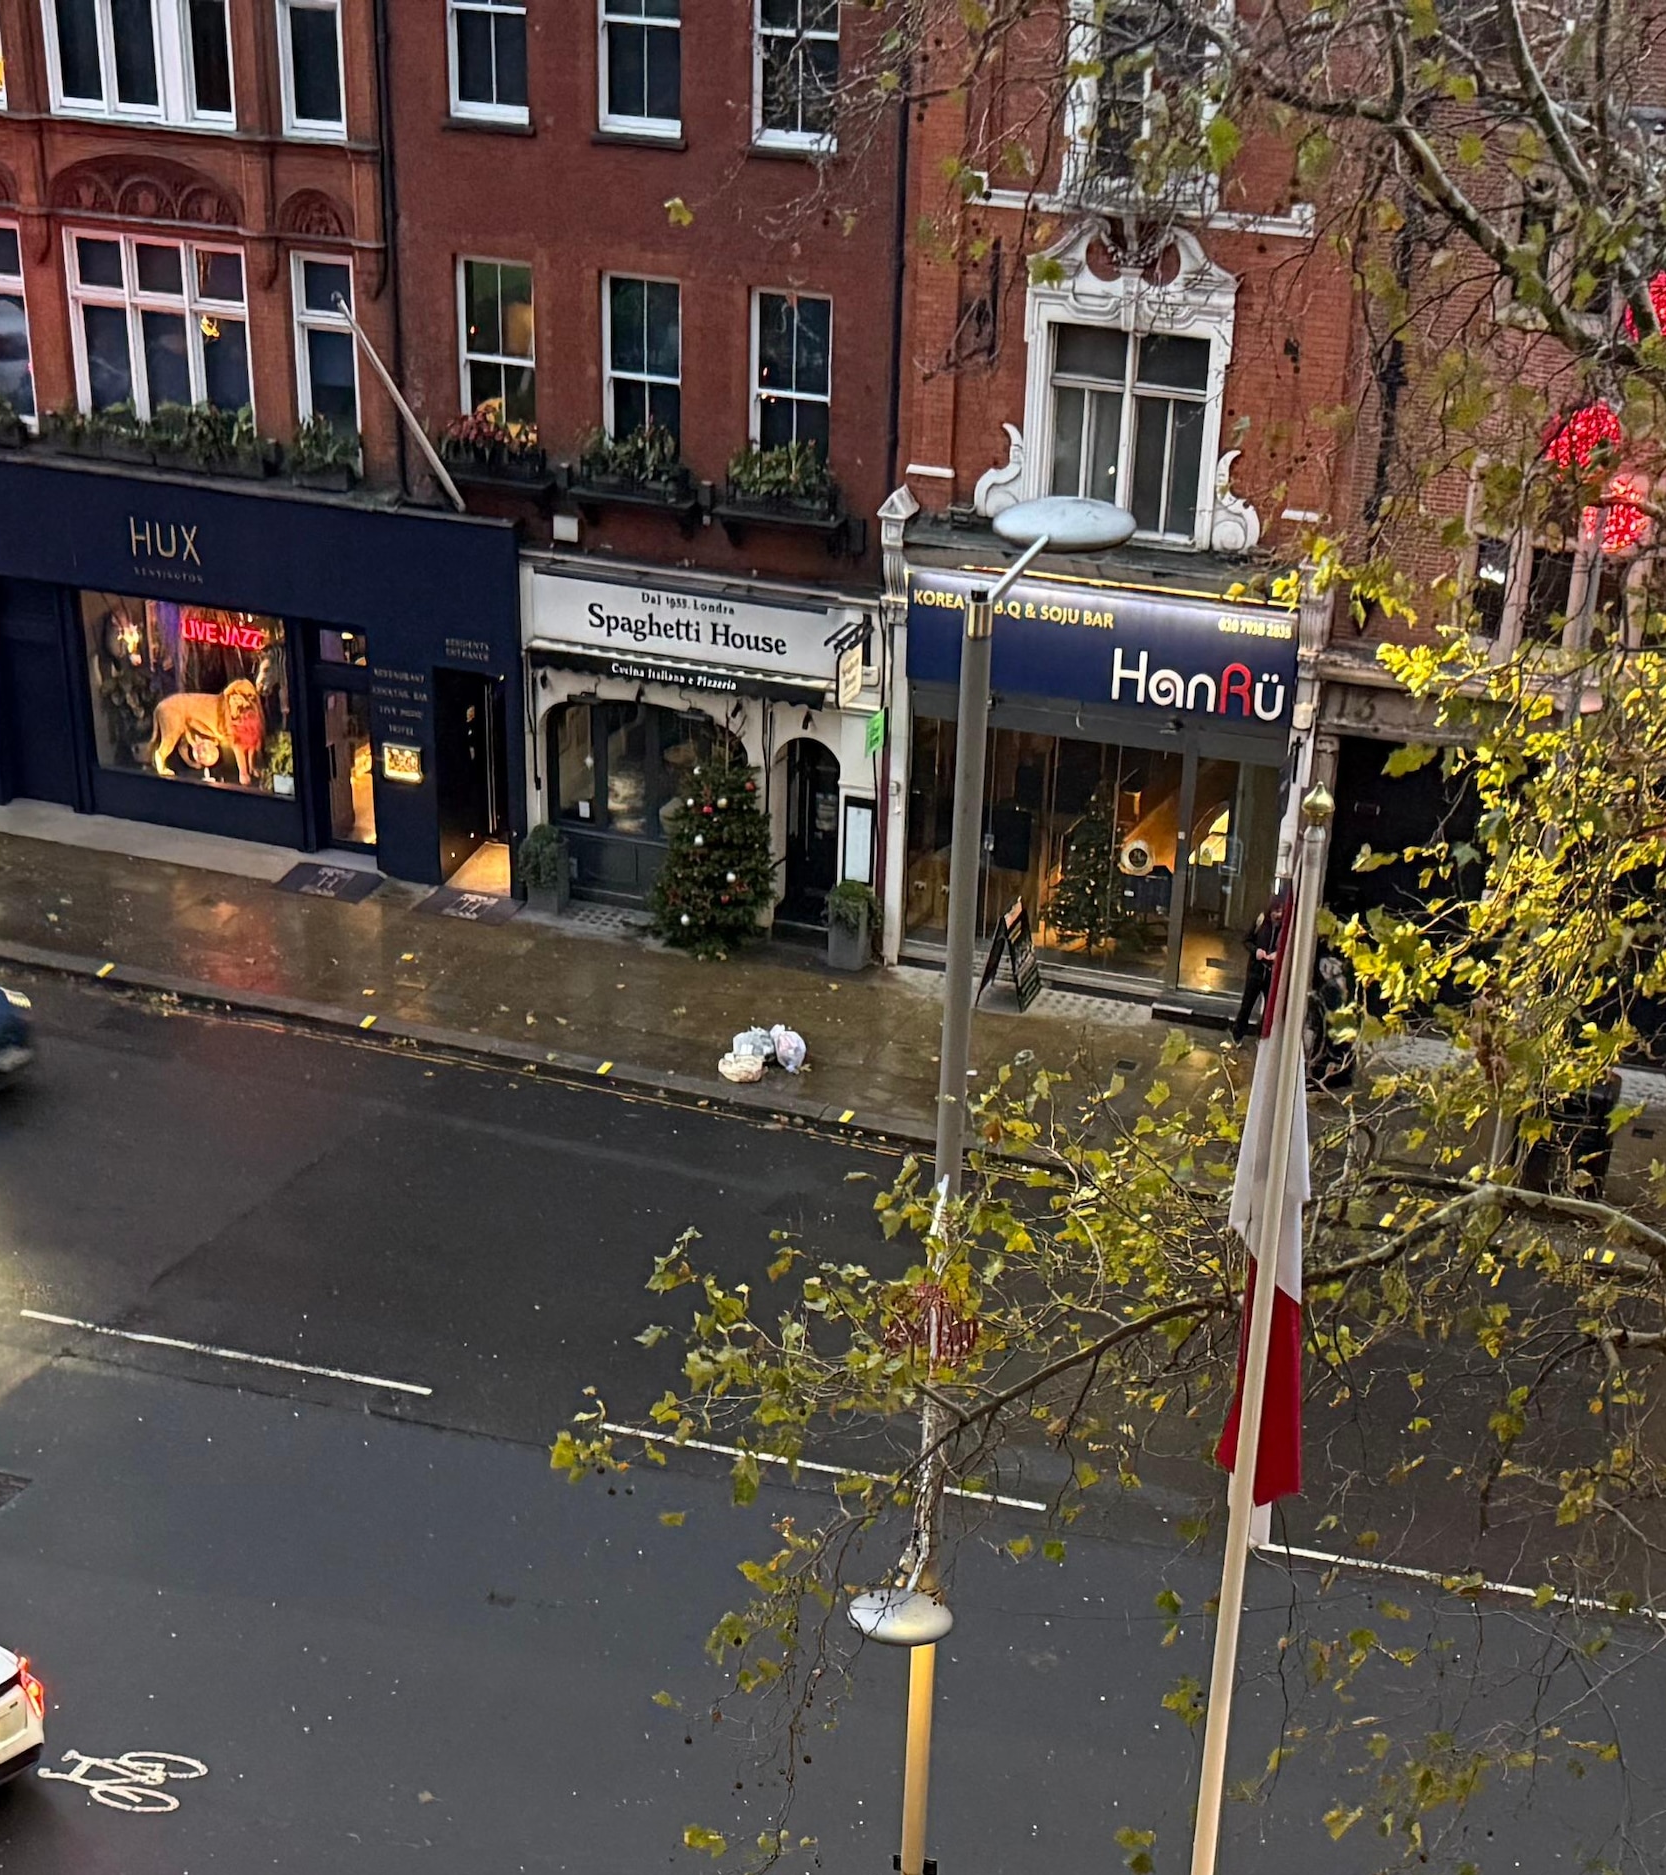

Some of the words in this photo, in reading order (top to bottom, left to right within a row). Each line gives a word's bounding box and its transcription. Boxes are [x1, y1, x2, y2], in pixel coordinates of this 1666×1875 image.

[129, 516, 201, 566] HUX
[641, 592, 661, 606] Dal
[693, 602, 735, 615] Londra
[914, 589, 965, 610] KOREA
[1024, 602, 1037, 619] &
[1039, 604, 1080, 625] SOJU
[1083, 611, 1114, 629] BAR
[182, 619, 217, 643] LIVE
[219, 624, 265, 651] JAZZ
[588, 603, 701, 642] Spaghetti
[710, 621, 787, 655] House
